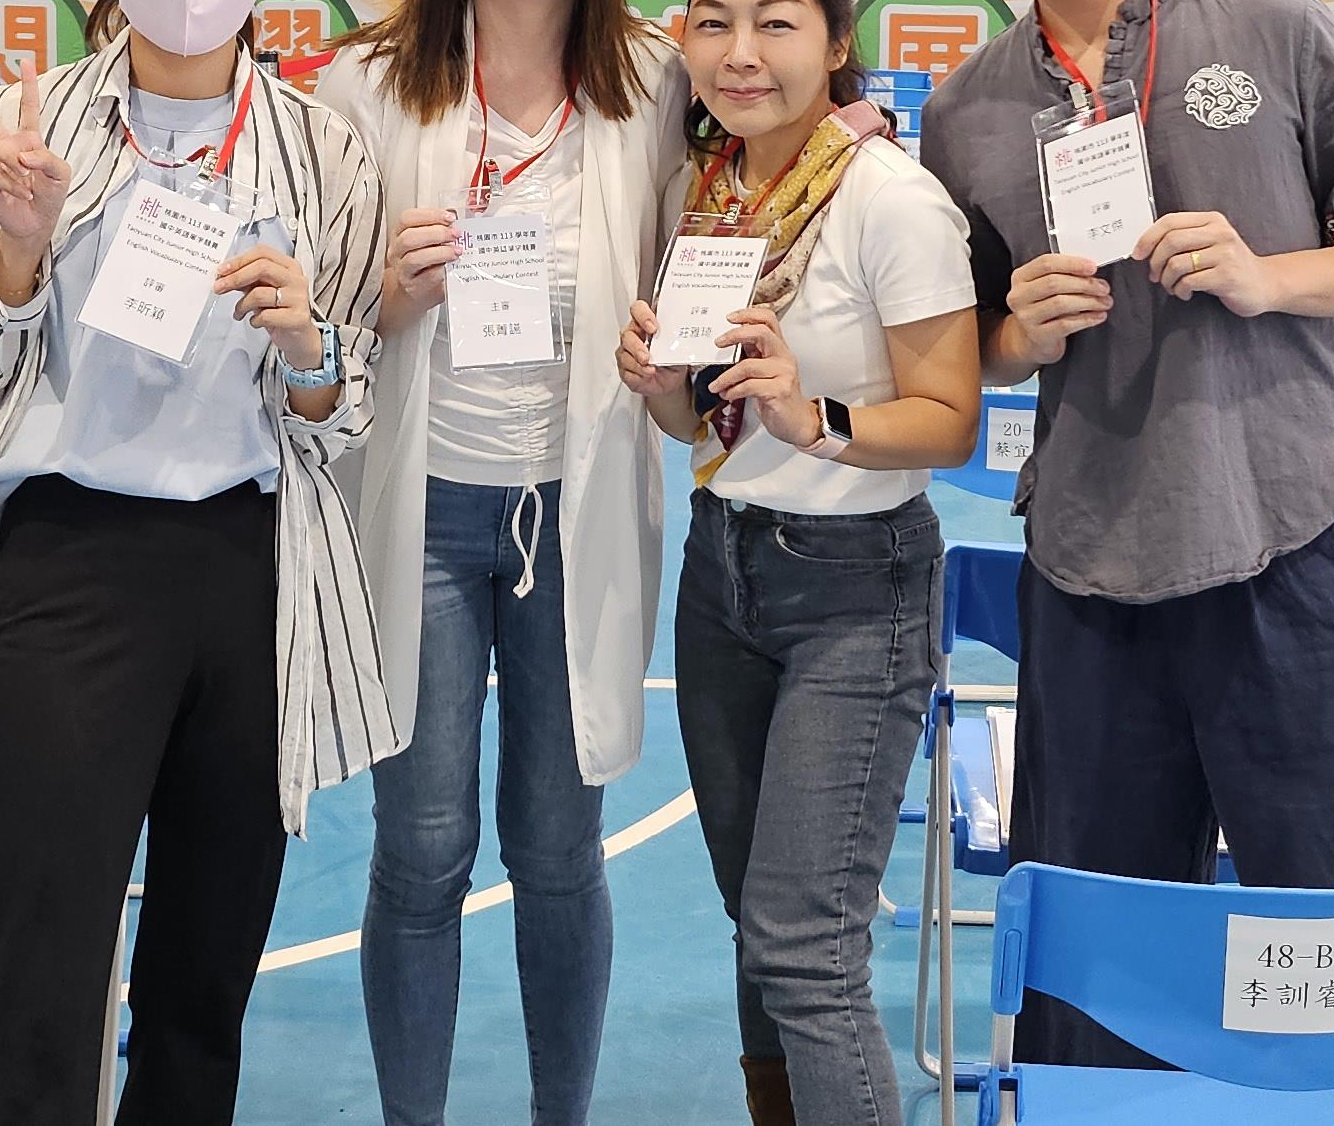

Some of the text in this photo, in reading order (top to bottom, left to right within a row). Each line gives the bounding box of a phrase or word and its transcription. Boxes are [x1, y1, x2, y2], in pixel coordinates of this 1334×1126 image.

[1003, 422, 1031, 437] 20-
[994, 441, 1030, 459] 蔡宜
[1257, 943, 1334, 969] 48-B
